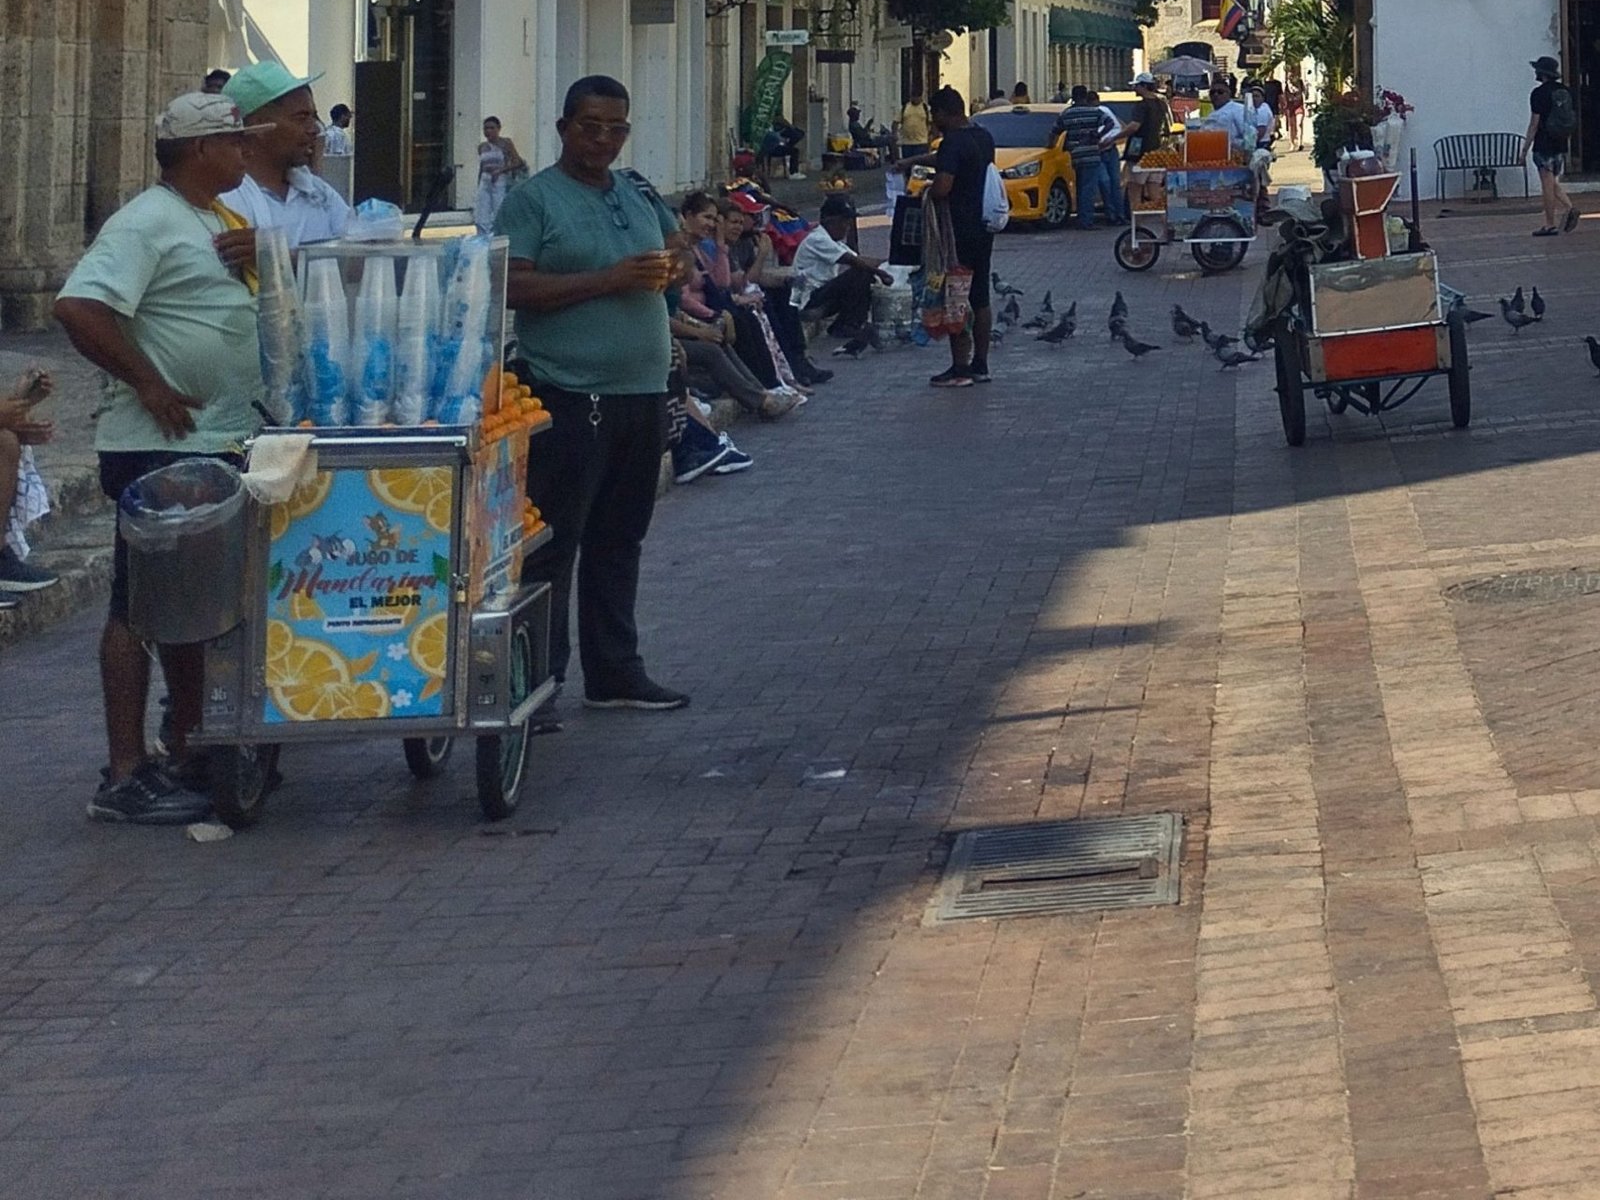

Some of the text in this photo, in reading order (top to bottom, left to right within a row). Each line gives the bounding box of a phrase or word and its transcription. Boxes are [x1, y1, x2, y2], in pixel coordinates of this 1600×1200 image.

[347, 550, 418, 566] JUGO DE
[277, 564, 438, 600] Mandarina
[349, 595, 421, 609] EL MEJOR
